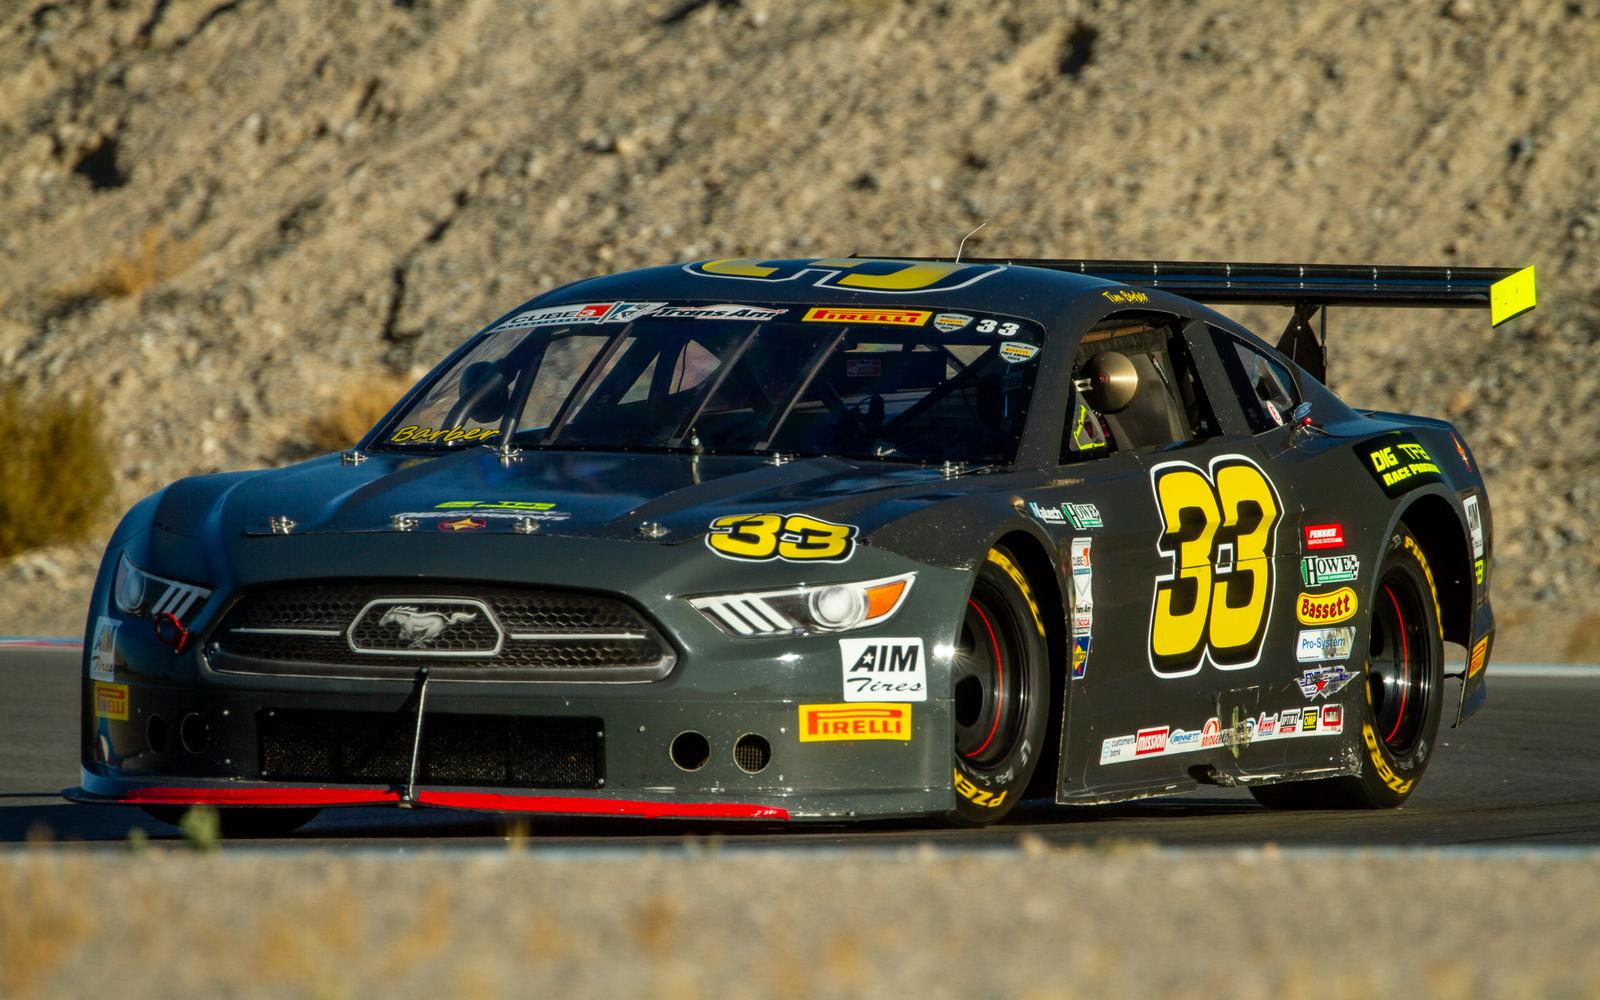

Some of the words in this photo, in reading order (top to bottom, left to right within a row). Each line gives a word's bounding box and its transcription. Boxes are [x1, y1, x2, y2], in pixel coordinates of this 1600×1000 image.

[812, 308, 922, 324] PIRELLI
[976, 319, 1020, 336] 33
[391, 425, 500, 442] Barber
[1370, 447, 1399, 472] DIG
[1382, 466, 1412, 486] RACE
[707, 513, 855, 562] 33
[1150, 458, 1280, 670] 33
[1304, 556, 1352, 586] HOWE
[1301, 593, 1350, 619] Bassett
[1302, 637, 1346, 649] Pro-System
[849, 645, 919, 672] AIM
[846, 677, 924, 693] Tires
[807, 708, 903, 736] PIRELLI
[1303, 714, 1317, 727] OMP
[1173, 732, 1200, 743] BENNETT
